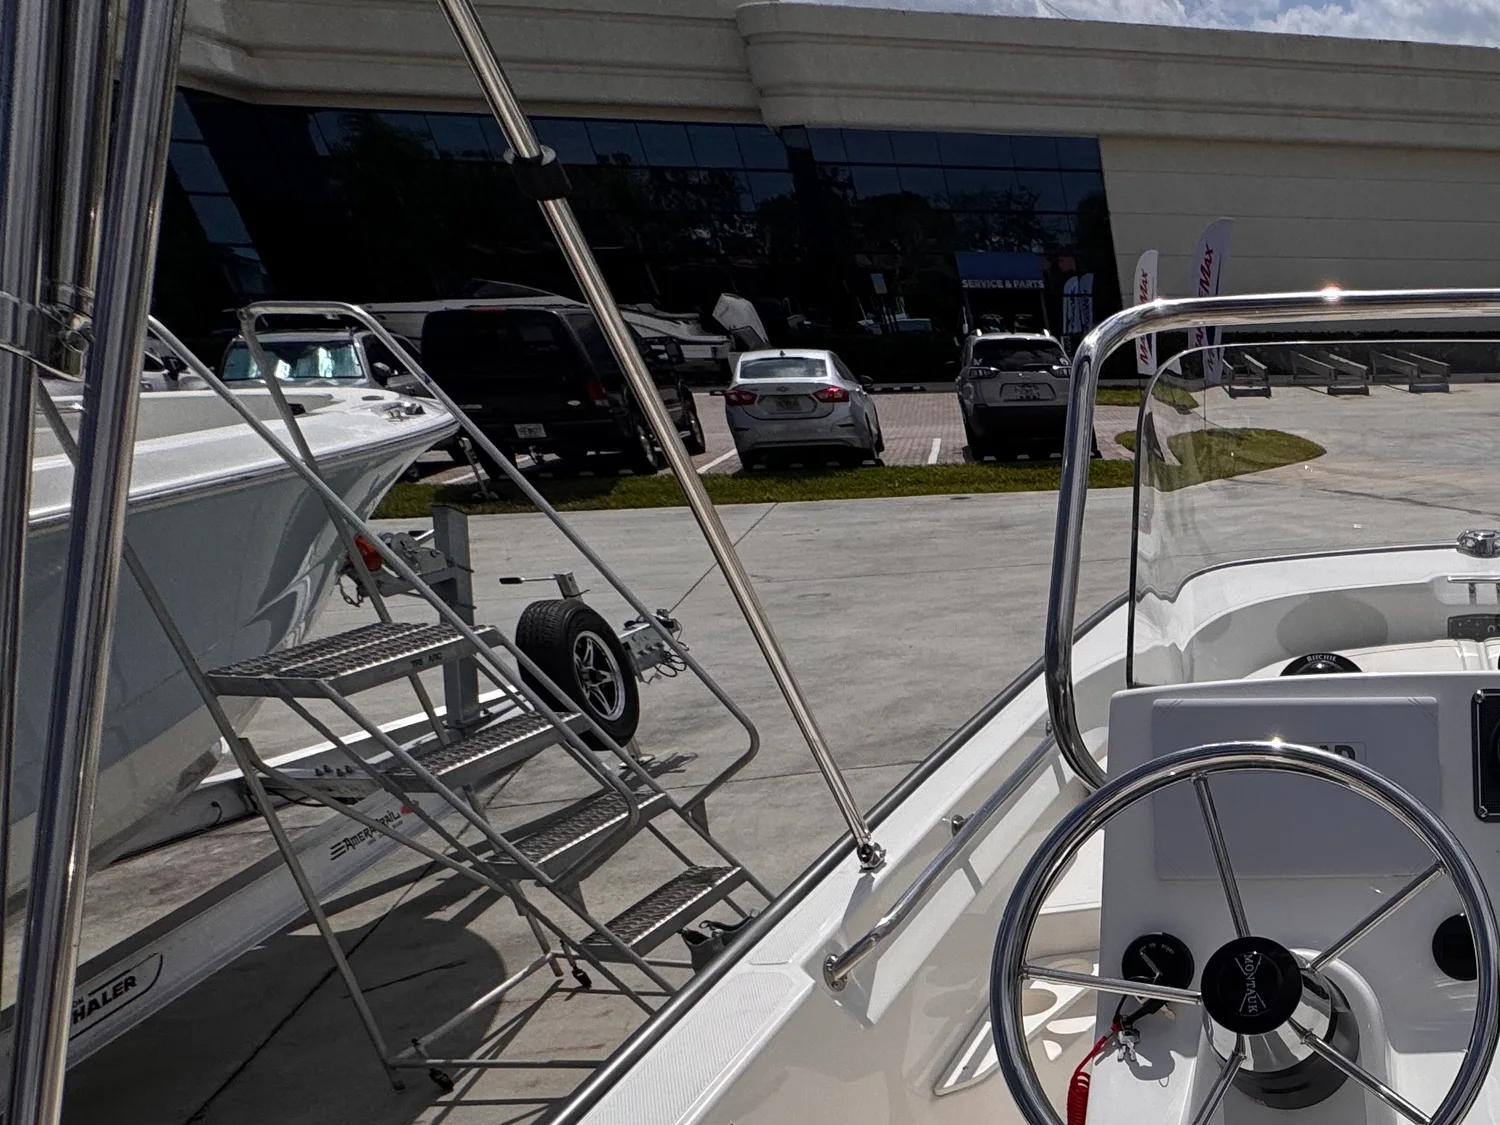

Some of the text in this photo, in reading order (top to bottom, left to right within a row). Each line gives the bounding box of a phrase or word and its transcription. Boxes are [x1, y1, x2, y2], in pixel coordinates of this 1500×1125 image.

[962, 280, 1044, 288] SERVICE & PARTS
[73, 976, 137, 1025] HALER
[1243, 954, 1258, 1013] MONTAUK
